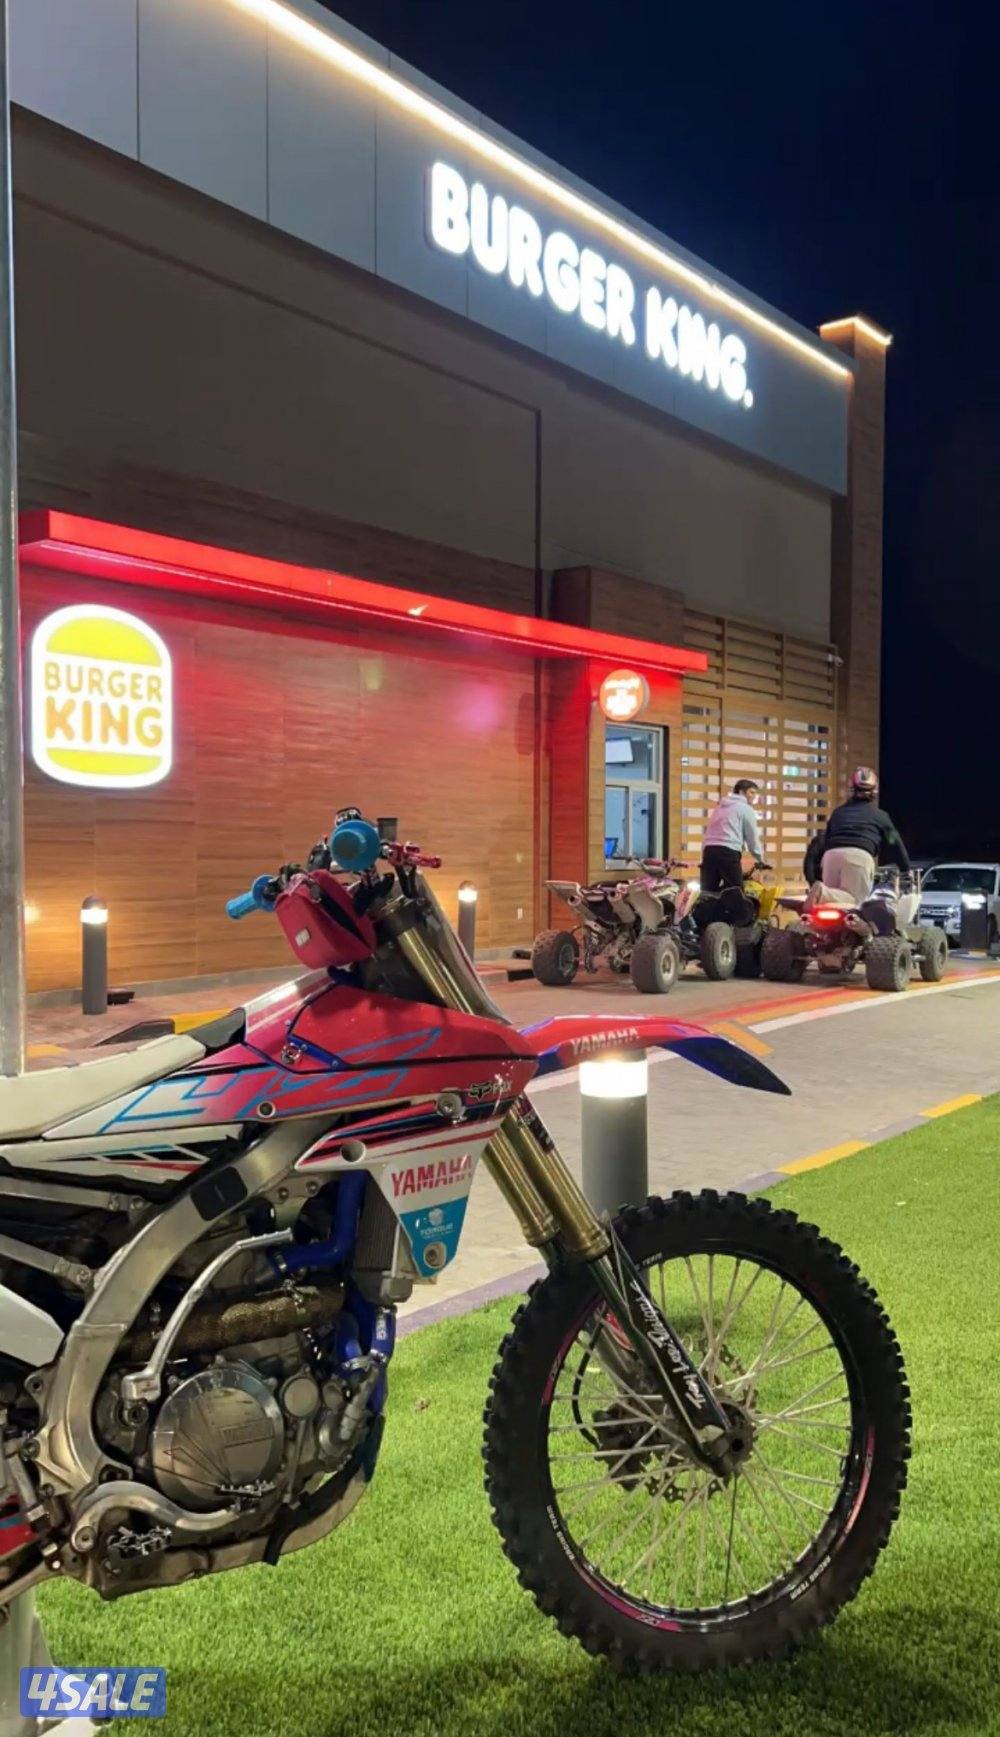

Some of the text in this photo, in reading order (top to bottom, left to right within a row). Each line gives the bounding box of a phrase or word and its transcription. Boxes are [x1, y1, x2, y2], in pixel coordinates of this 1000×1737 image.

[429, 161, 754, 409] BURGER KING.
[44, 661, 164, 703] BURGER
[45, 696, 164, 748] KING
[569, 1027, 641, 1056] YAMAHA
[391, 1155, 473, 1198] YAMAHA
